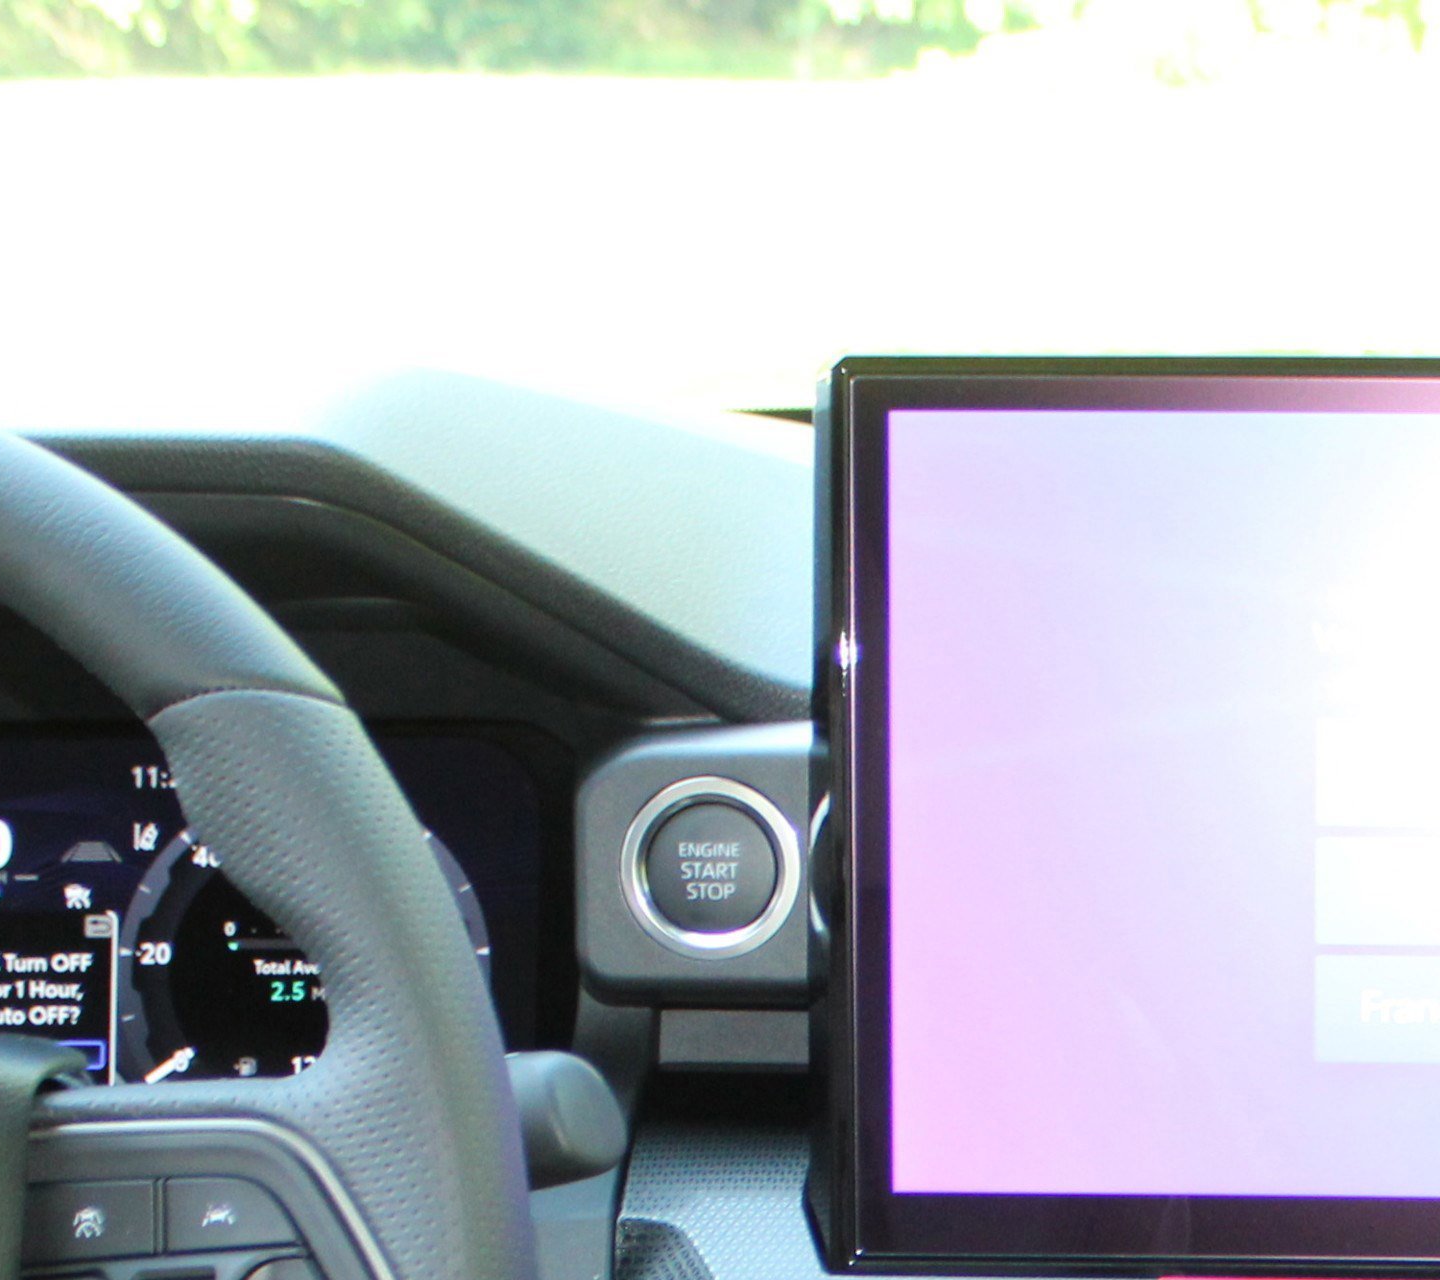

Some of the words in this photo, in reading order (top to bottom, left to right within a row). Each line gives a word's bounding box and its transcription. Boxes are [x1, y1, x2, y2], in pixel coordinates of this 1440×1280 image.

[130, 766, 176, 789] 11:
[677, 842, 742, 859] ENGINE
[679, 861, 738, 881] START
[685, 882, 736, 901] STOP
[2, 953, 48, 974] Turn
[50, 952, 94, 974] OFF
[138, 941, 172, 967] 20
[252, 958, 291, 976] Total
[14, 980, 25, 999] 1
[28, 980, 85, 1002] Hour,
[270, 979, 306, 1003] 2.5
[28, 1005, 82, 1026] OFF?
